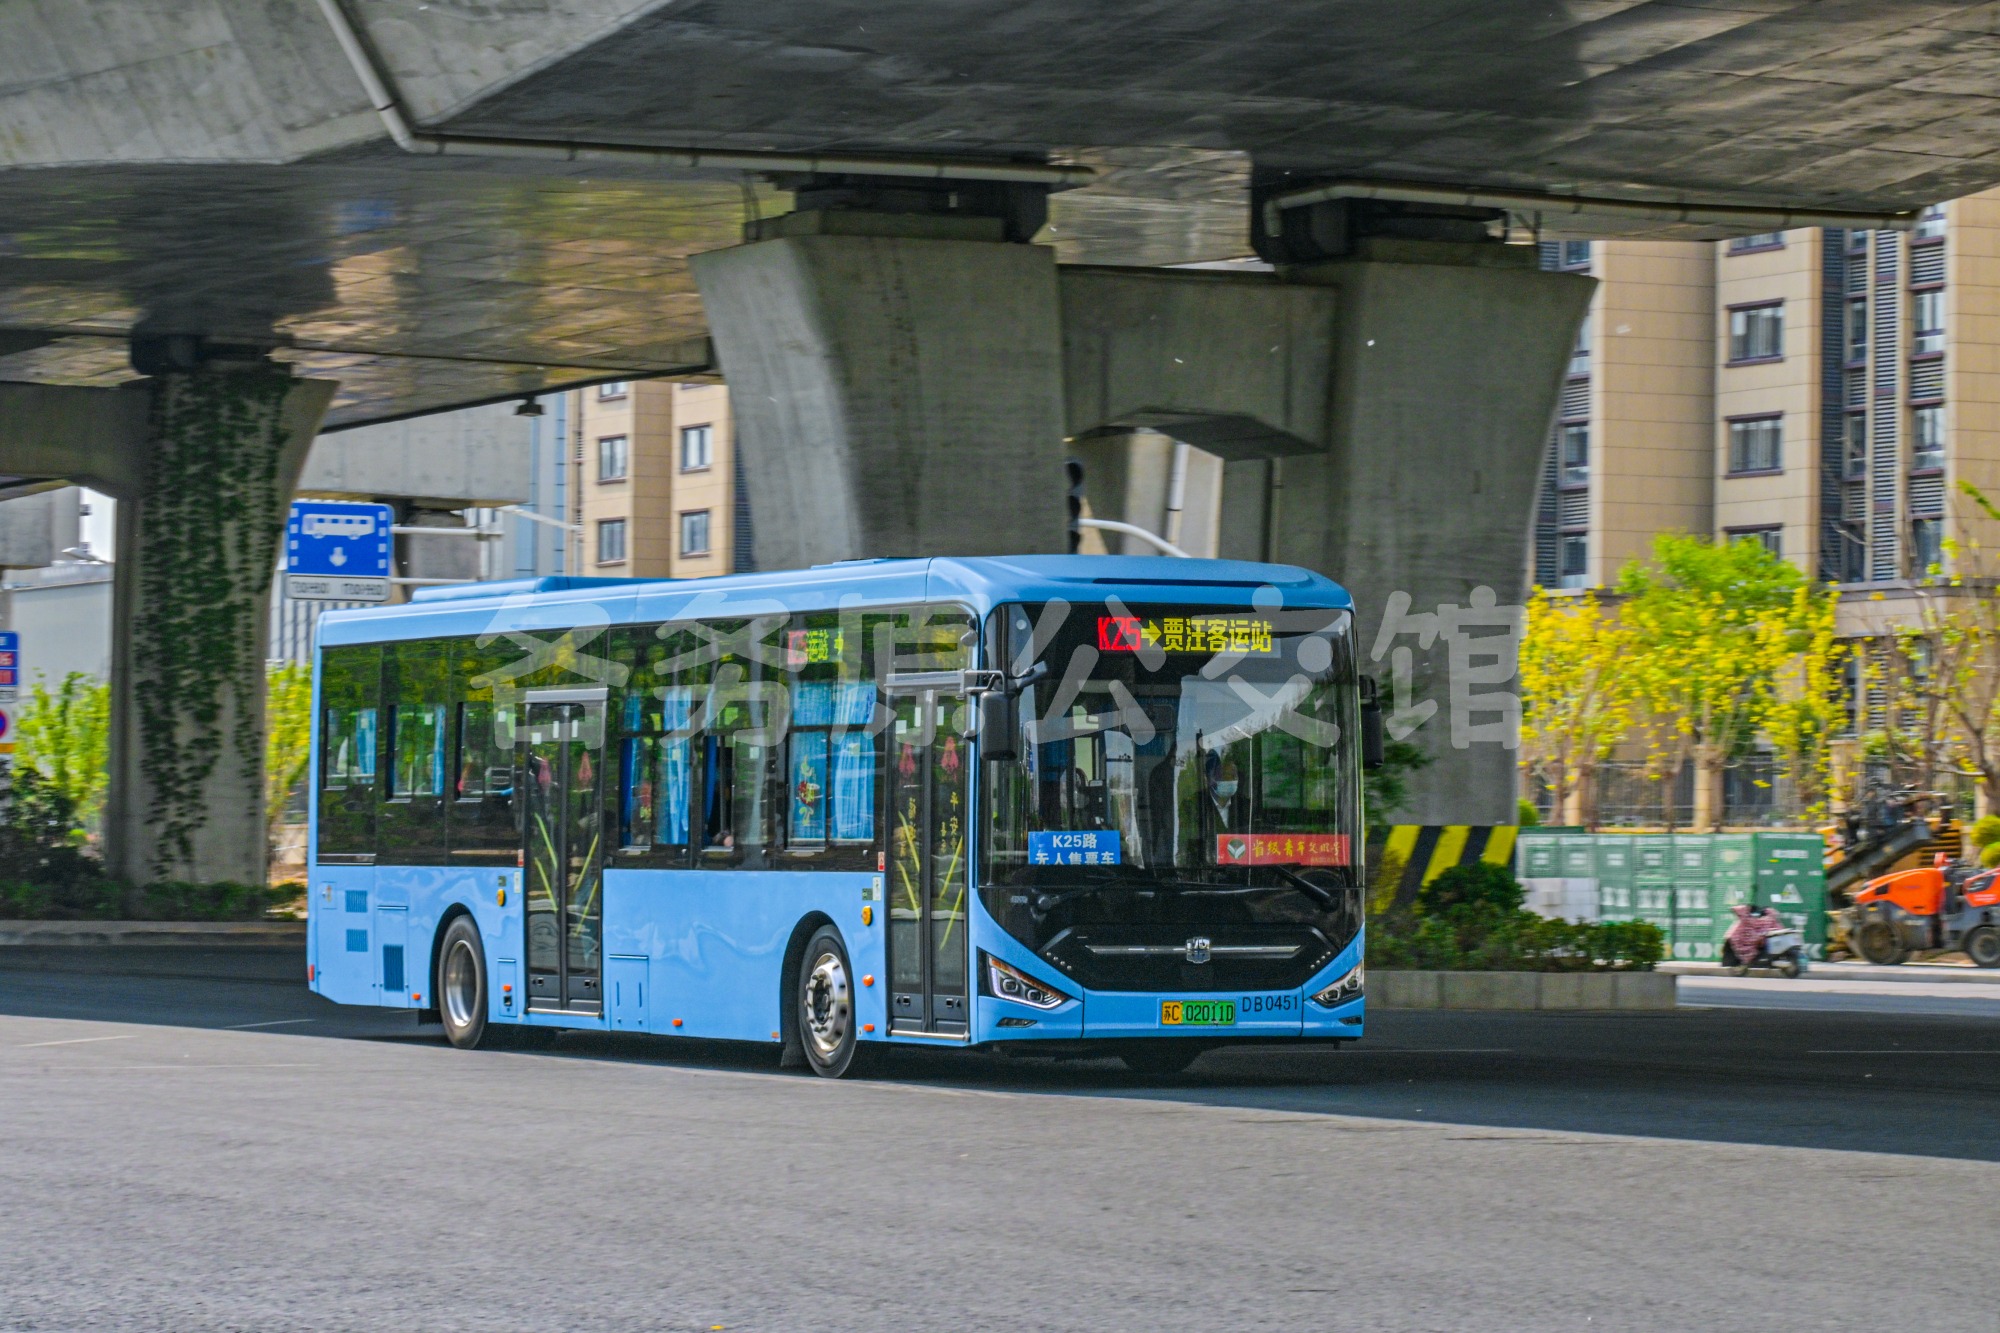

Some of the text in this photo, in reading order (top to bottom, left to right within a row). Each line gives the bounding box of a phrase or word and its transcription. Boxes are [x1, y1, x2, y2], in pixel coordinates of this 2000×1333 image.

[1098, 617, 1272, 652] K25 贾汪客运站
[1052, 833, 1097, 849] K25路
[1035, 851, 1115, 865] 无人售票车
[1242, 996, 1298, 1012] DB0451
[1163, 1004, 1234, 1021] 苏C02011D
